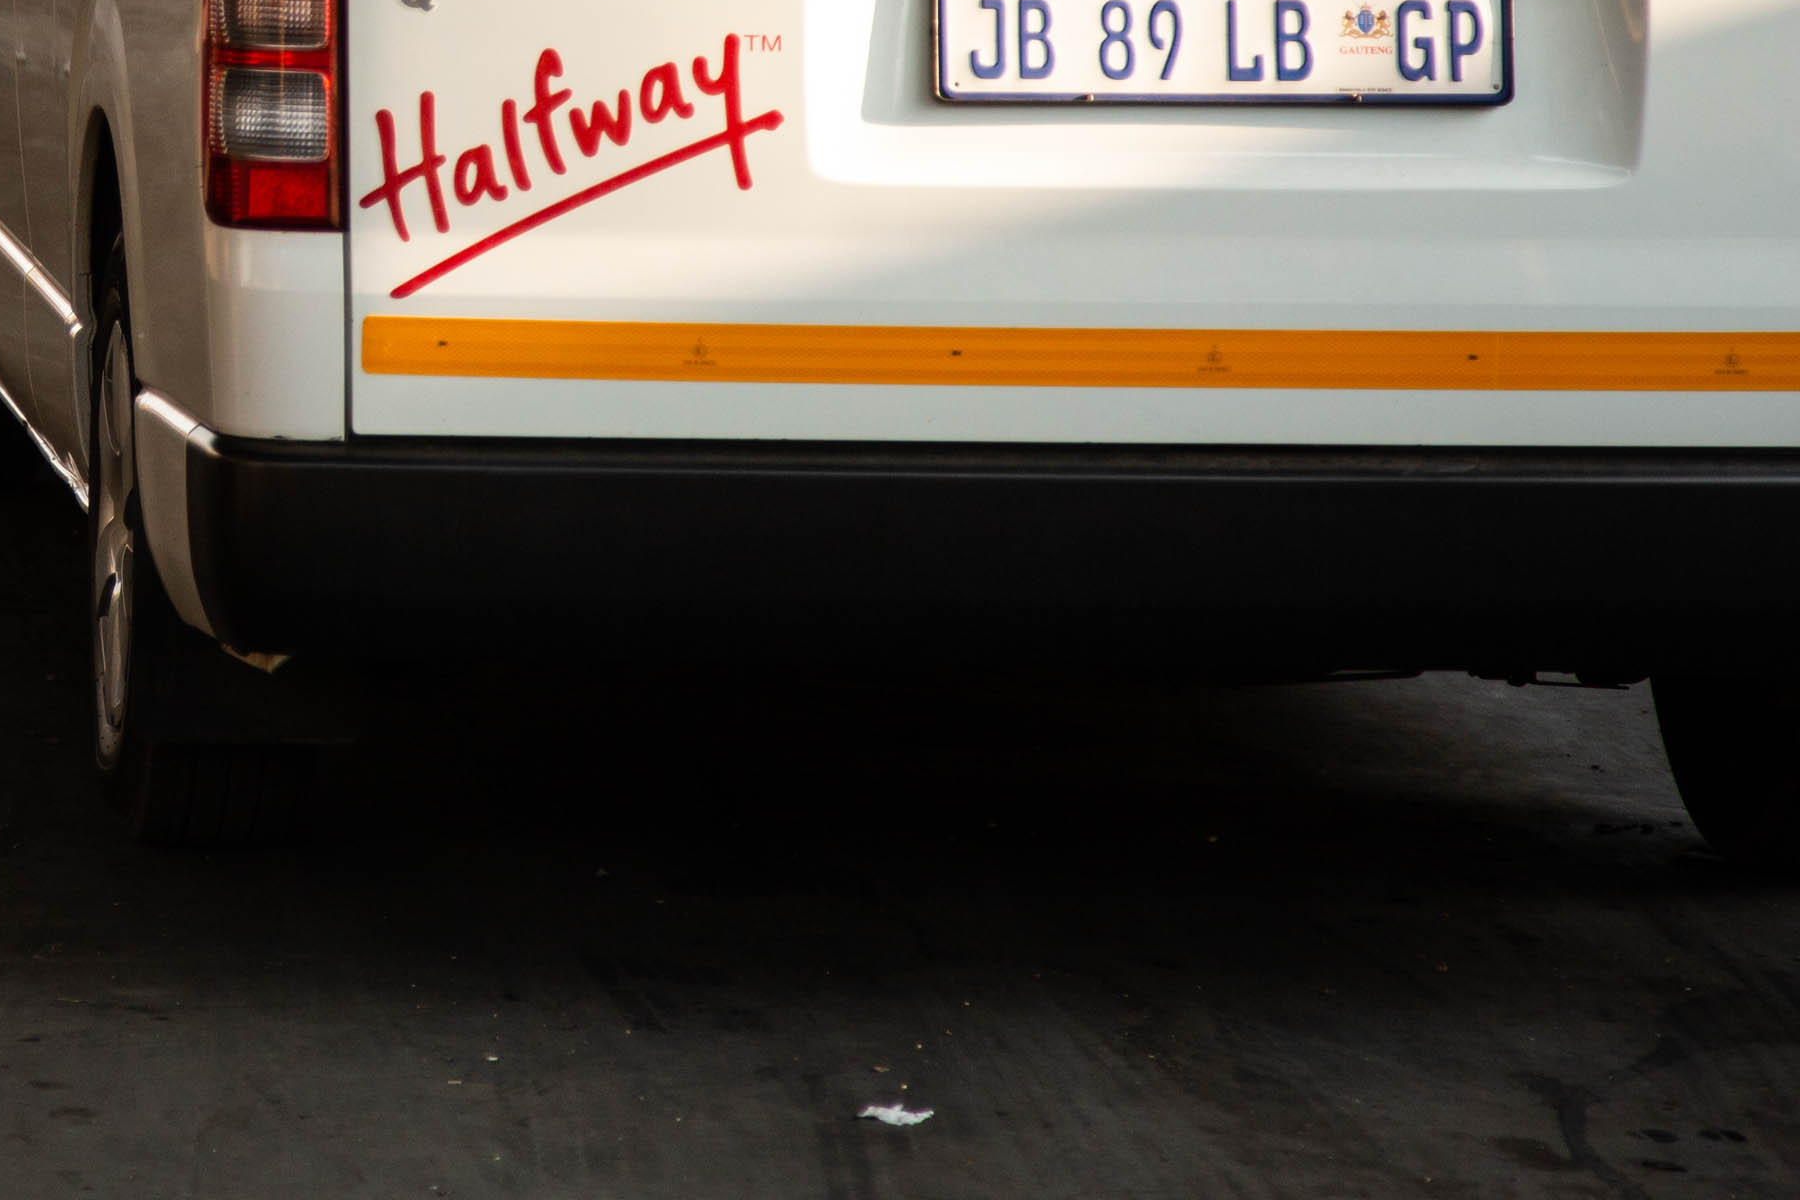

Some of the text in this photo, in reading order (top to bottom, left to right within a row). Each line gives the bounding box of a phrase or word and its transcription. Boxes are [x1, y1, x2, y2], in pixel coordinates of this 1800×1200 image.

[1226, 0, 1314, 82] LB
[1398, 0, 1484, 82] GP
[1339, 45, 1393, 56] GAUTENG
[359, 33, 782, 242] Halfway TM
